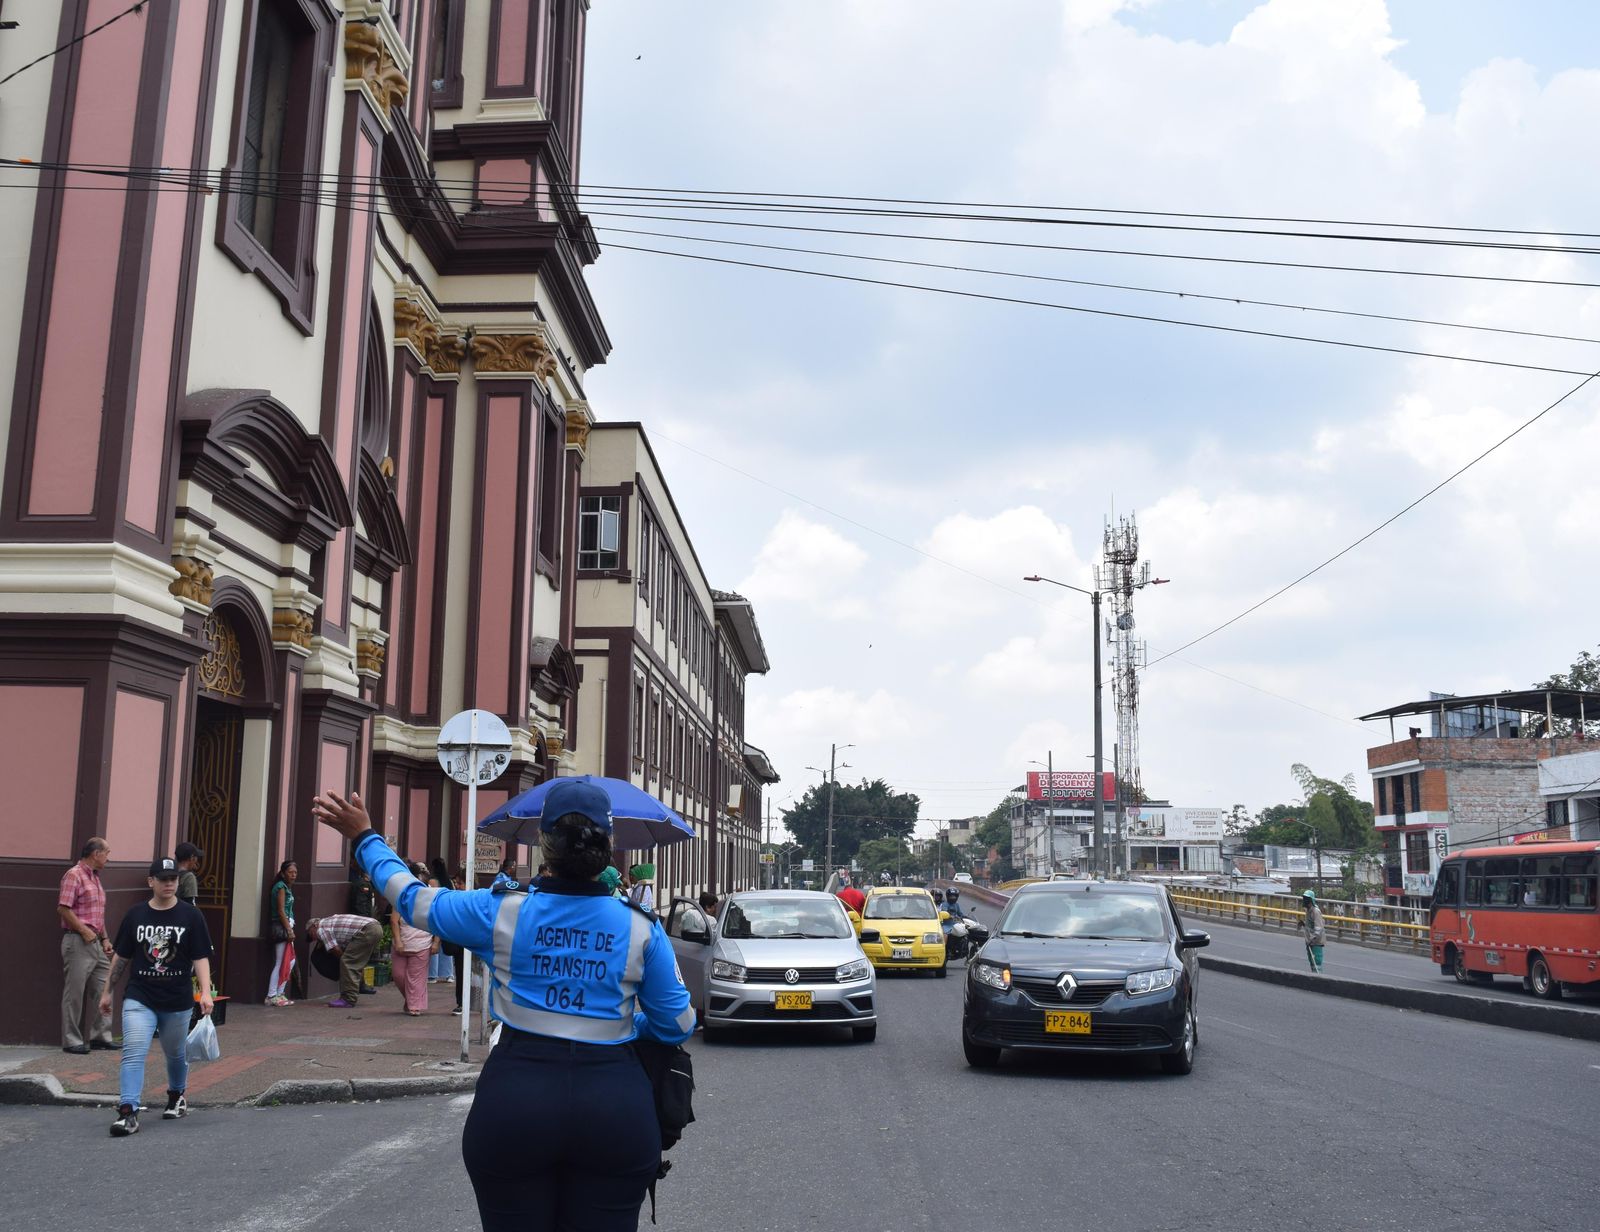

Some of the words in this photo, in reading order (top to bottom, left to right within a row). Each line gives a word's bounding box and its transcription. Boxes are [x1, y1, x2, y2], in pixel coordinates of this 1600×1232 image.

[136, 925, 186, 944] GOOFY
[534, 926, 589, 950] AGENTE
[595, 931, 615, 952] DE
[531, 954, 607, 980] TRANSITO
[545, 985, 585, 1011] 064
